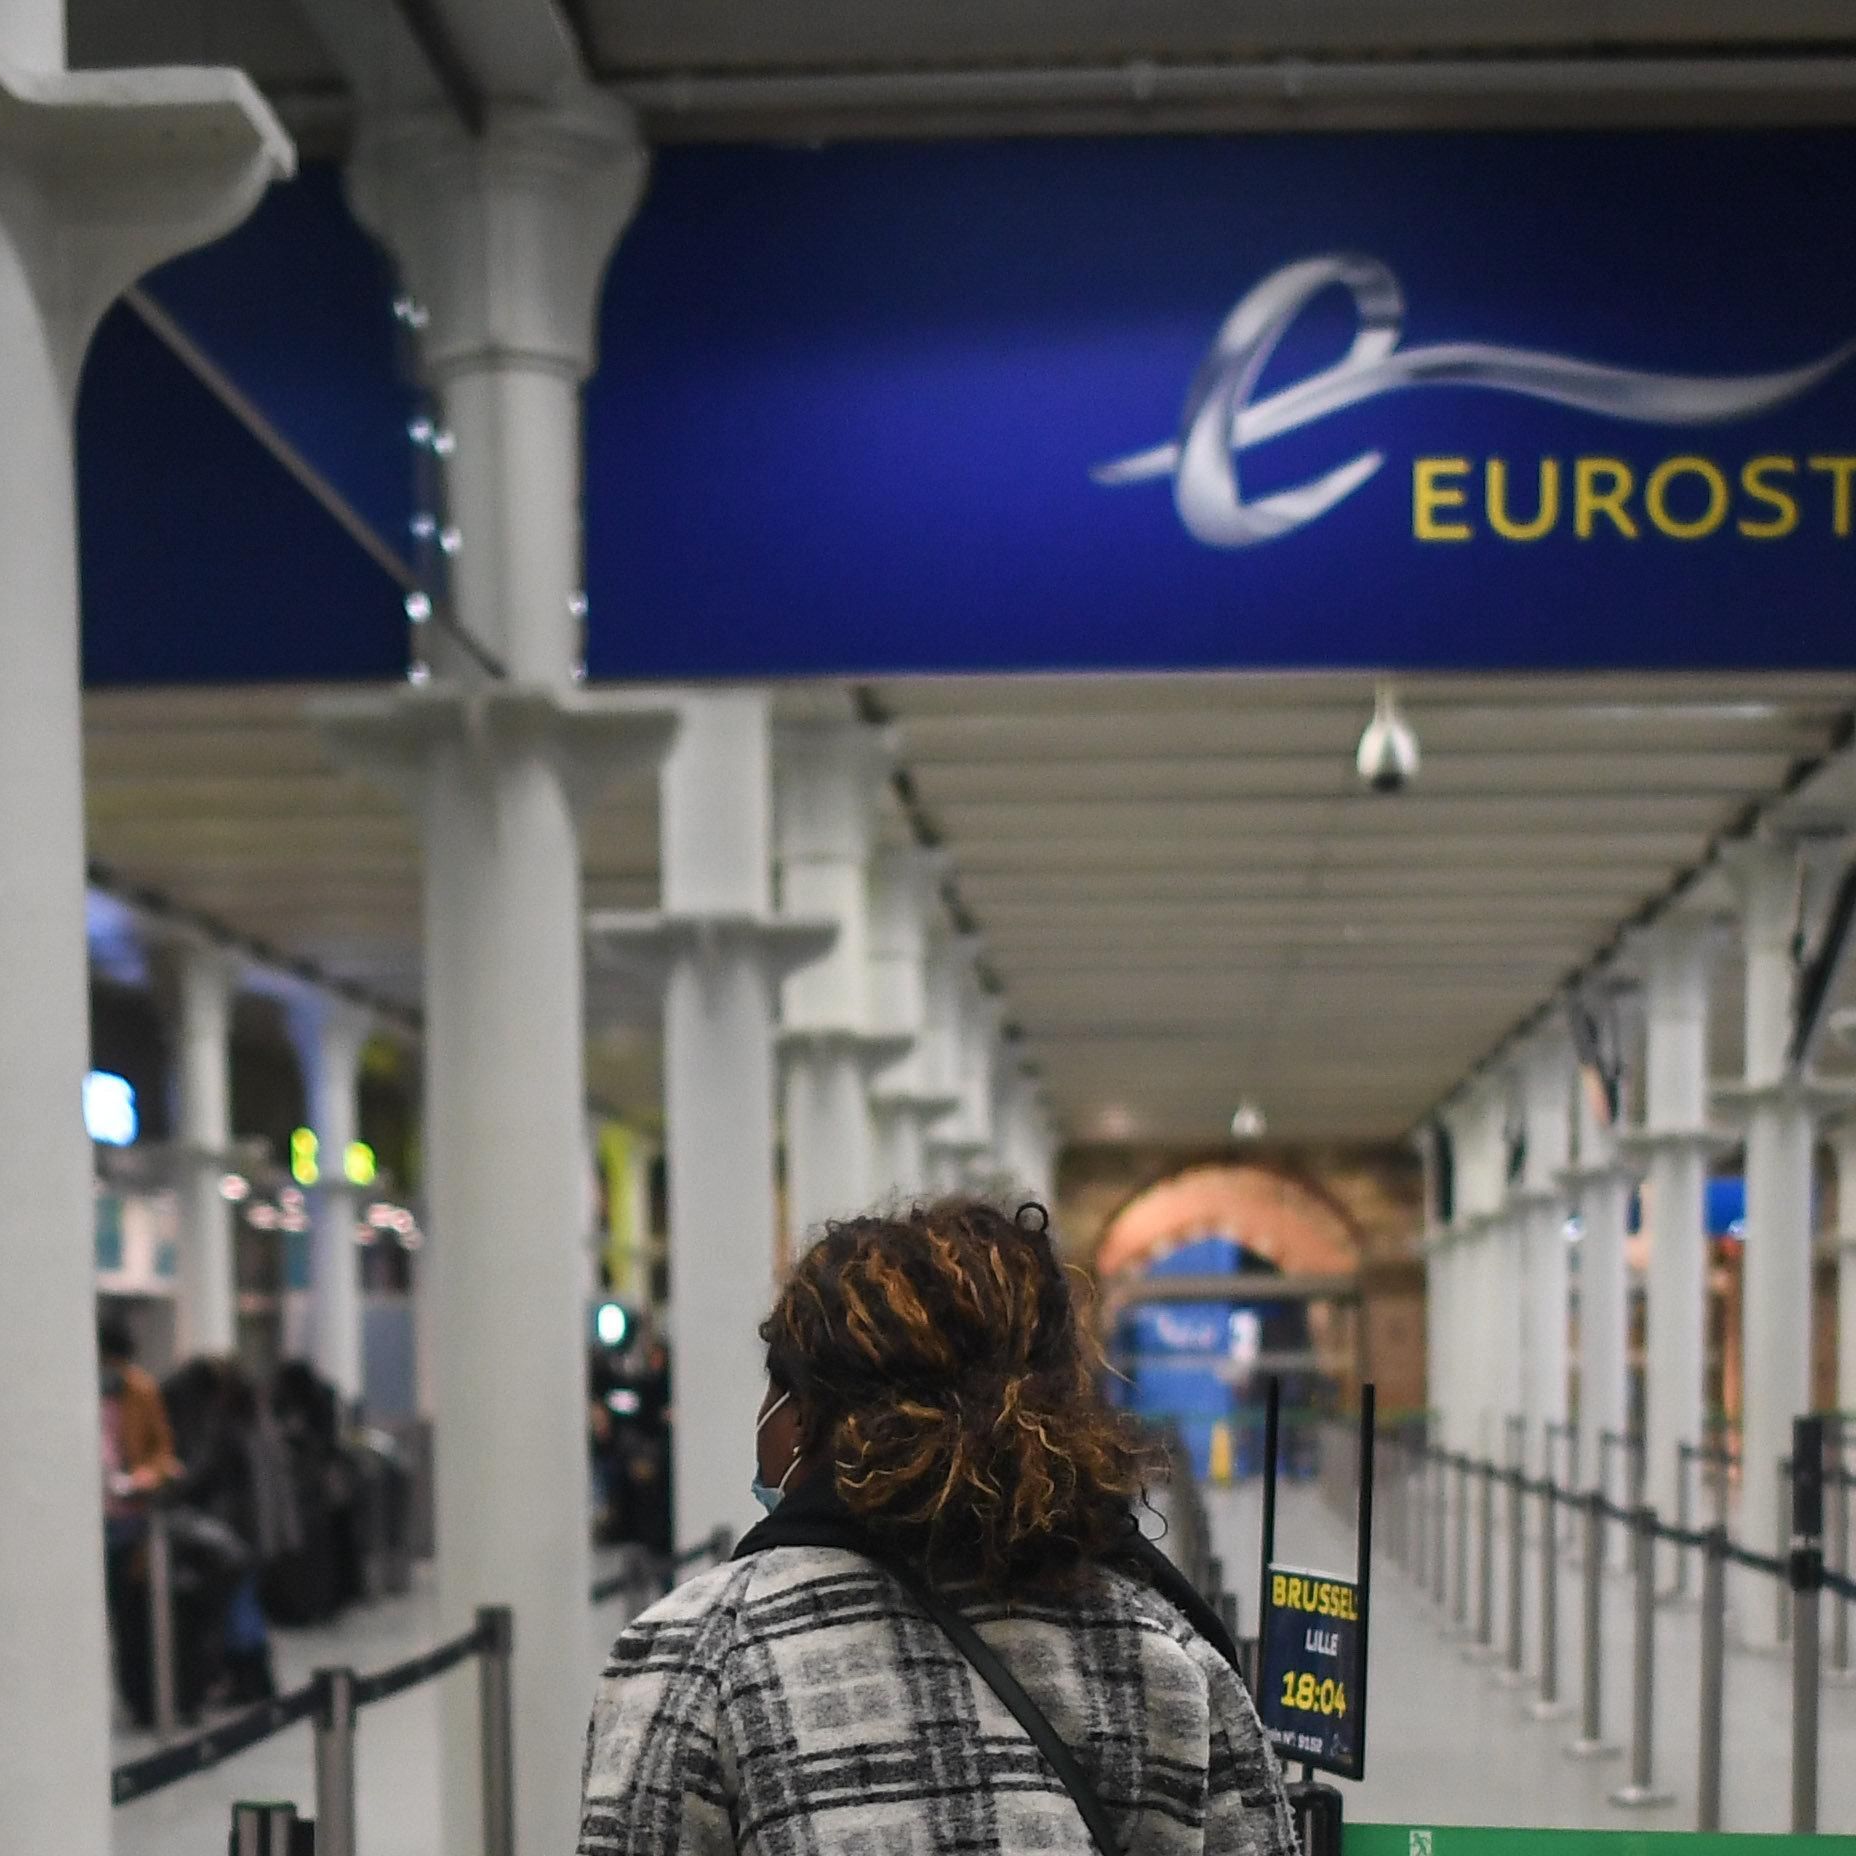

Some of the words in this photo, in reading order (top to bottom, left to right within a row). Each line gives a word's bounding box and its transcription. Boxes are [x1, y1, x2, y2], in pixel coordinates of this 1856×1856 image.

[1272, 1574, 1358, 1621] BRUSSEL
[1305, 1628, 1339, 1656] LILLE
[1280, 1670, 1347, 1719] 18:04
